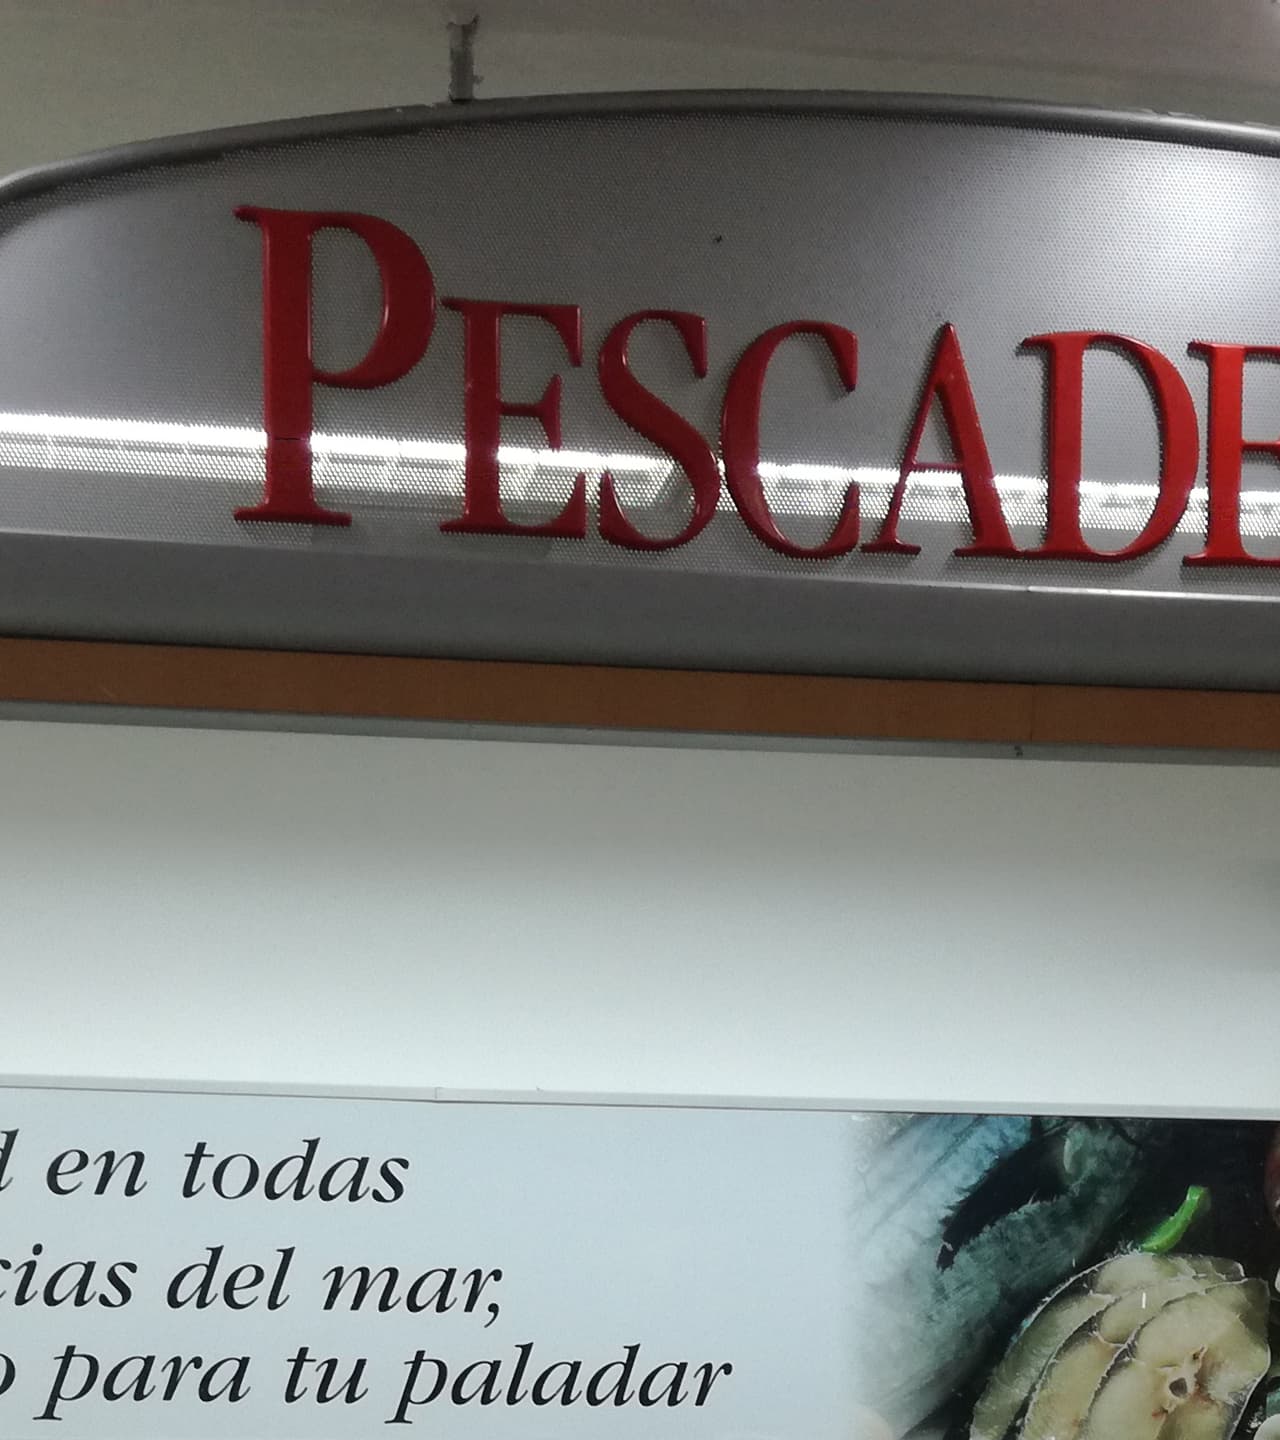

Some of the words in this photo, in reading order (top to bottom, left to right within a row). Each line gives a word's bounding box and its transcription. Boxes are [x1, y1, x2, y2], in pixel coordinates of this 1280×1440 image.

[45, 1148, 149, 1198] en
[181, 1136, 410, 1204] todas
[165, 1244, 297, 1312] del
[321, 1265, 504, 1328] mar,
[31, 1344, 252, 1422] para
[283, 1345, 370, 1405] tu
[383, 1341, 734, 1426] paladar
